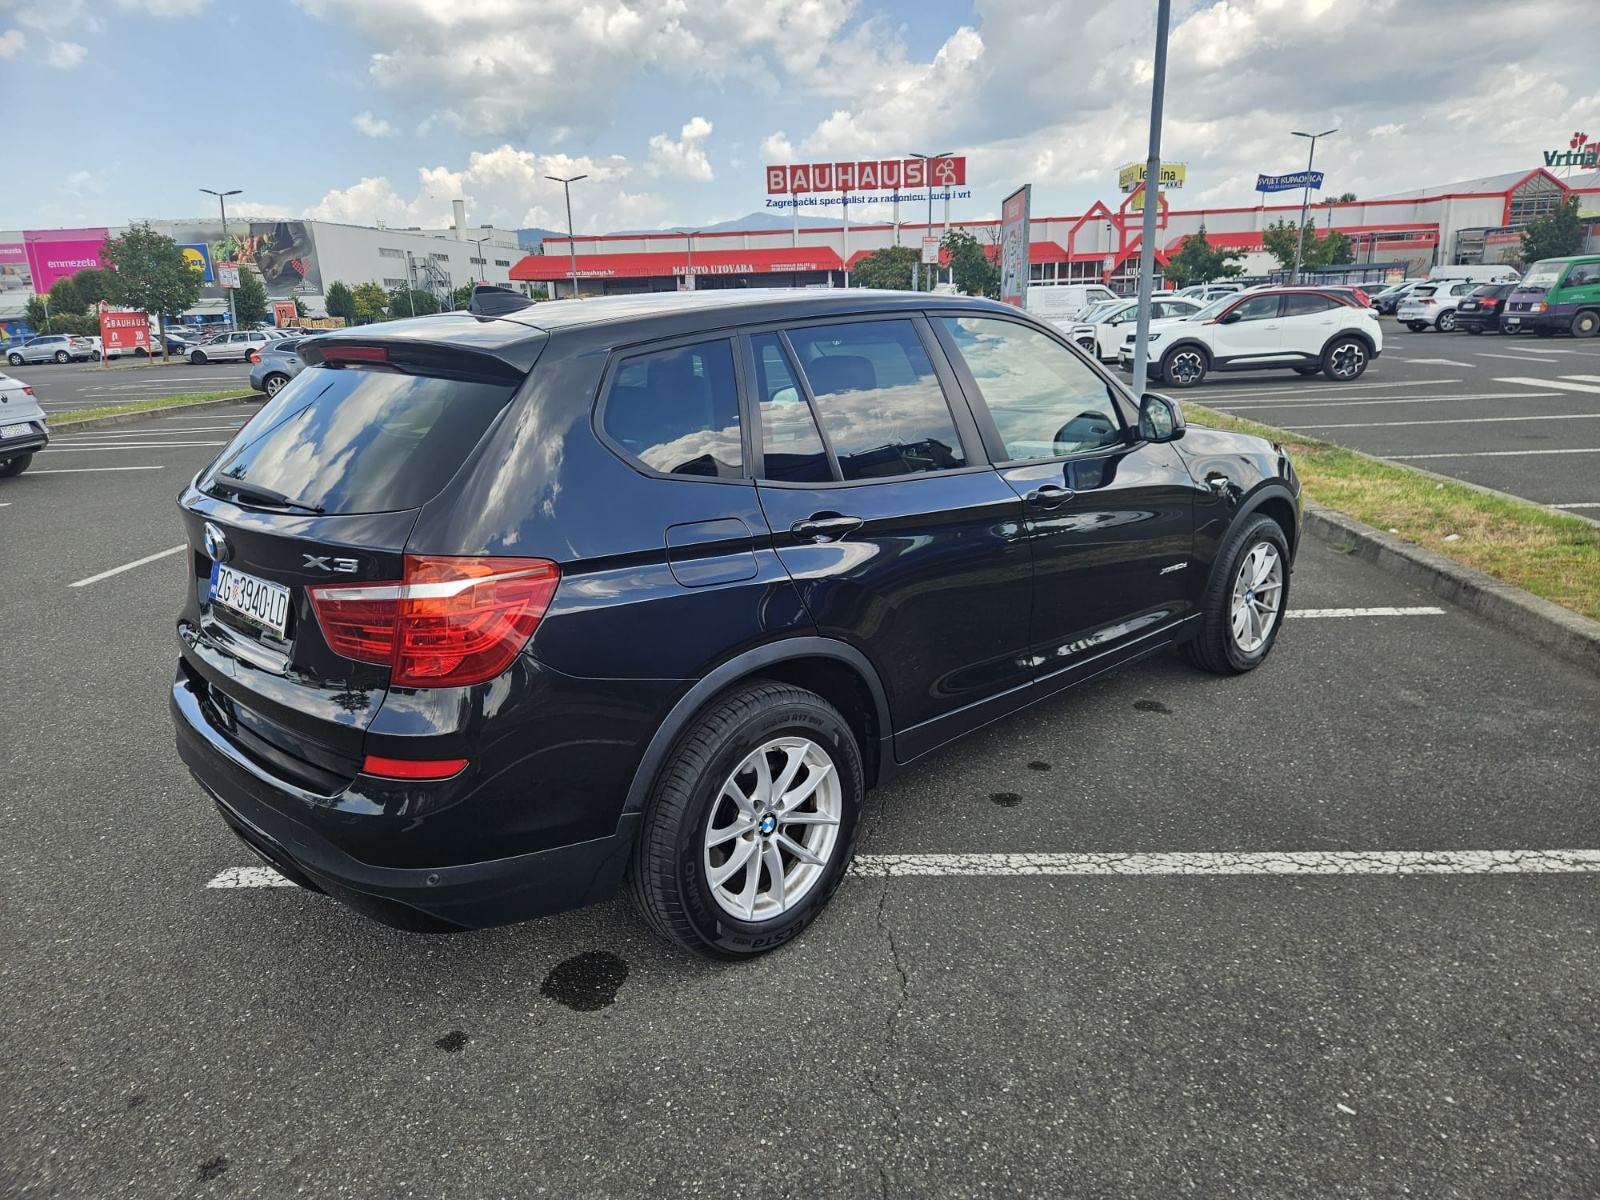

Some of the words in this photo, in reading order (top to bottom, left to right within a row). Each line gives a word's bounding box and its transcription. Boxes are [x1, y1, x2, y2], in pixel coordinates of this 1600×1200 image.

[770, 163, 922, 190] BAUHAUS
[1139, 168, 1176, 181] leina
[1258, 177, 1280, 185] SVIJET
[766, 197, 817, 208] Zagrebački
[958, 190, 971, 199] vrt
[47, 258, 97, 268] emmezeta
[711, 263, 754, 274] UTOVARA
[111, 319, 146, 328] BAUHAUS
[302, 554, 359, 573] X3
[217, 568, 232, 601] ZG
